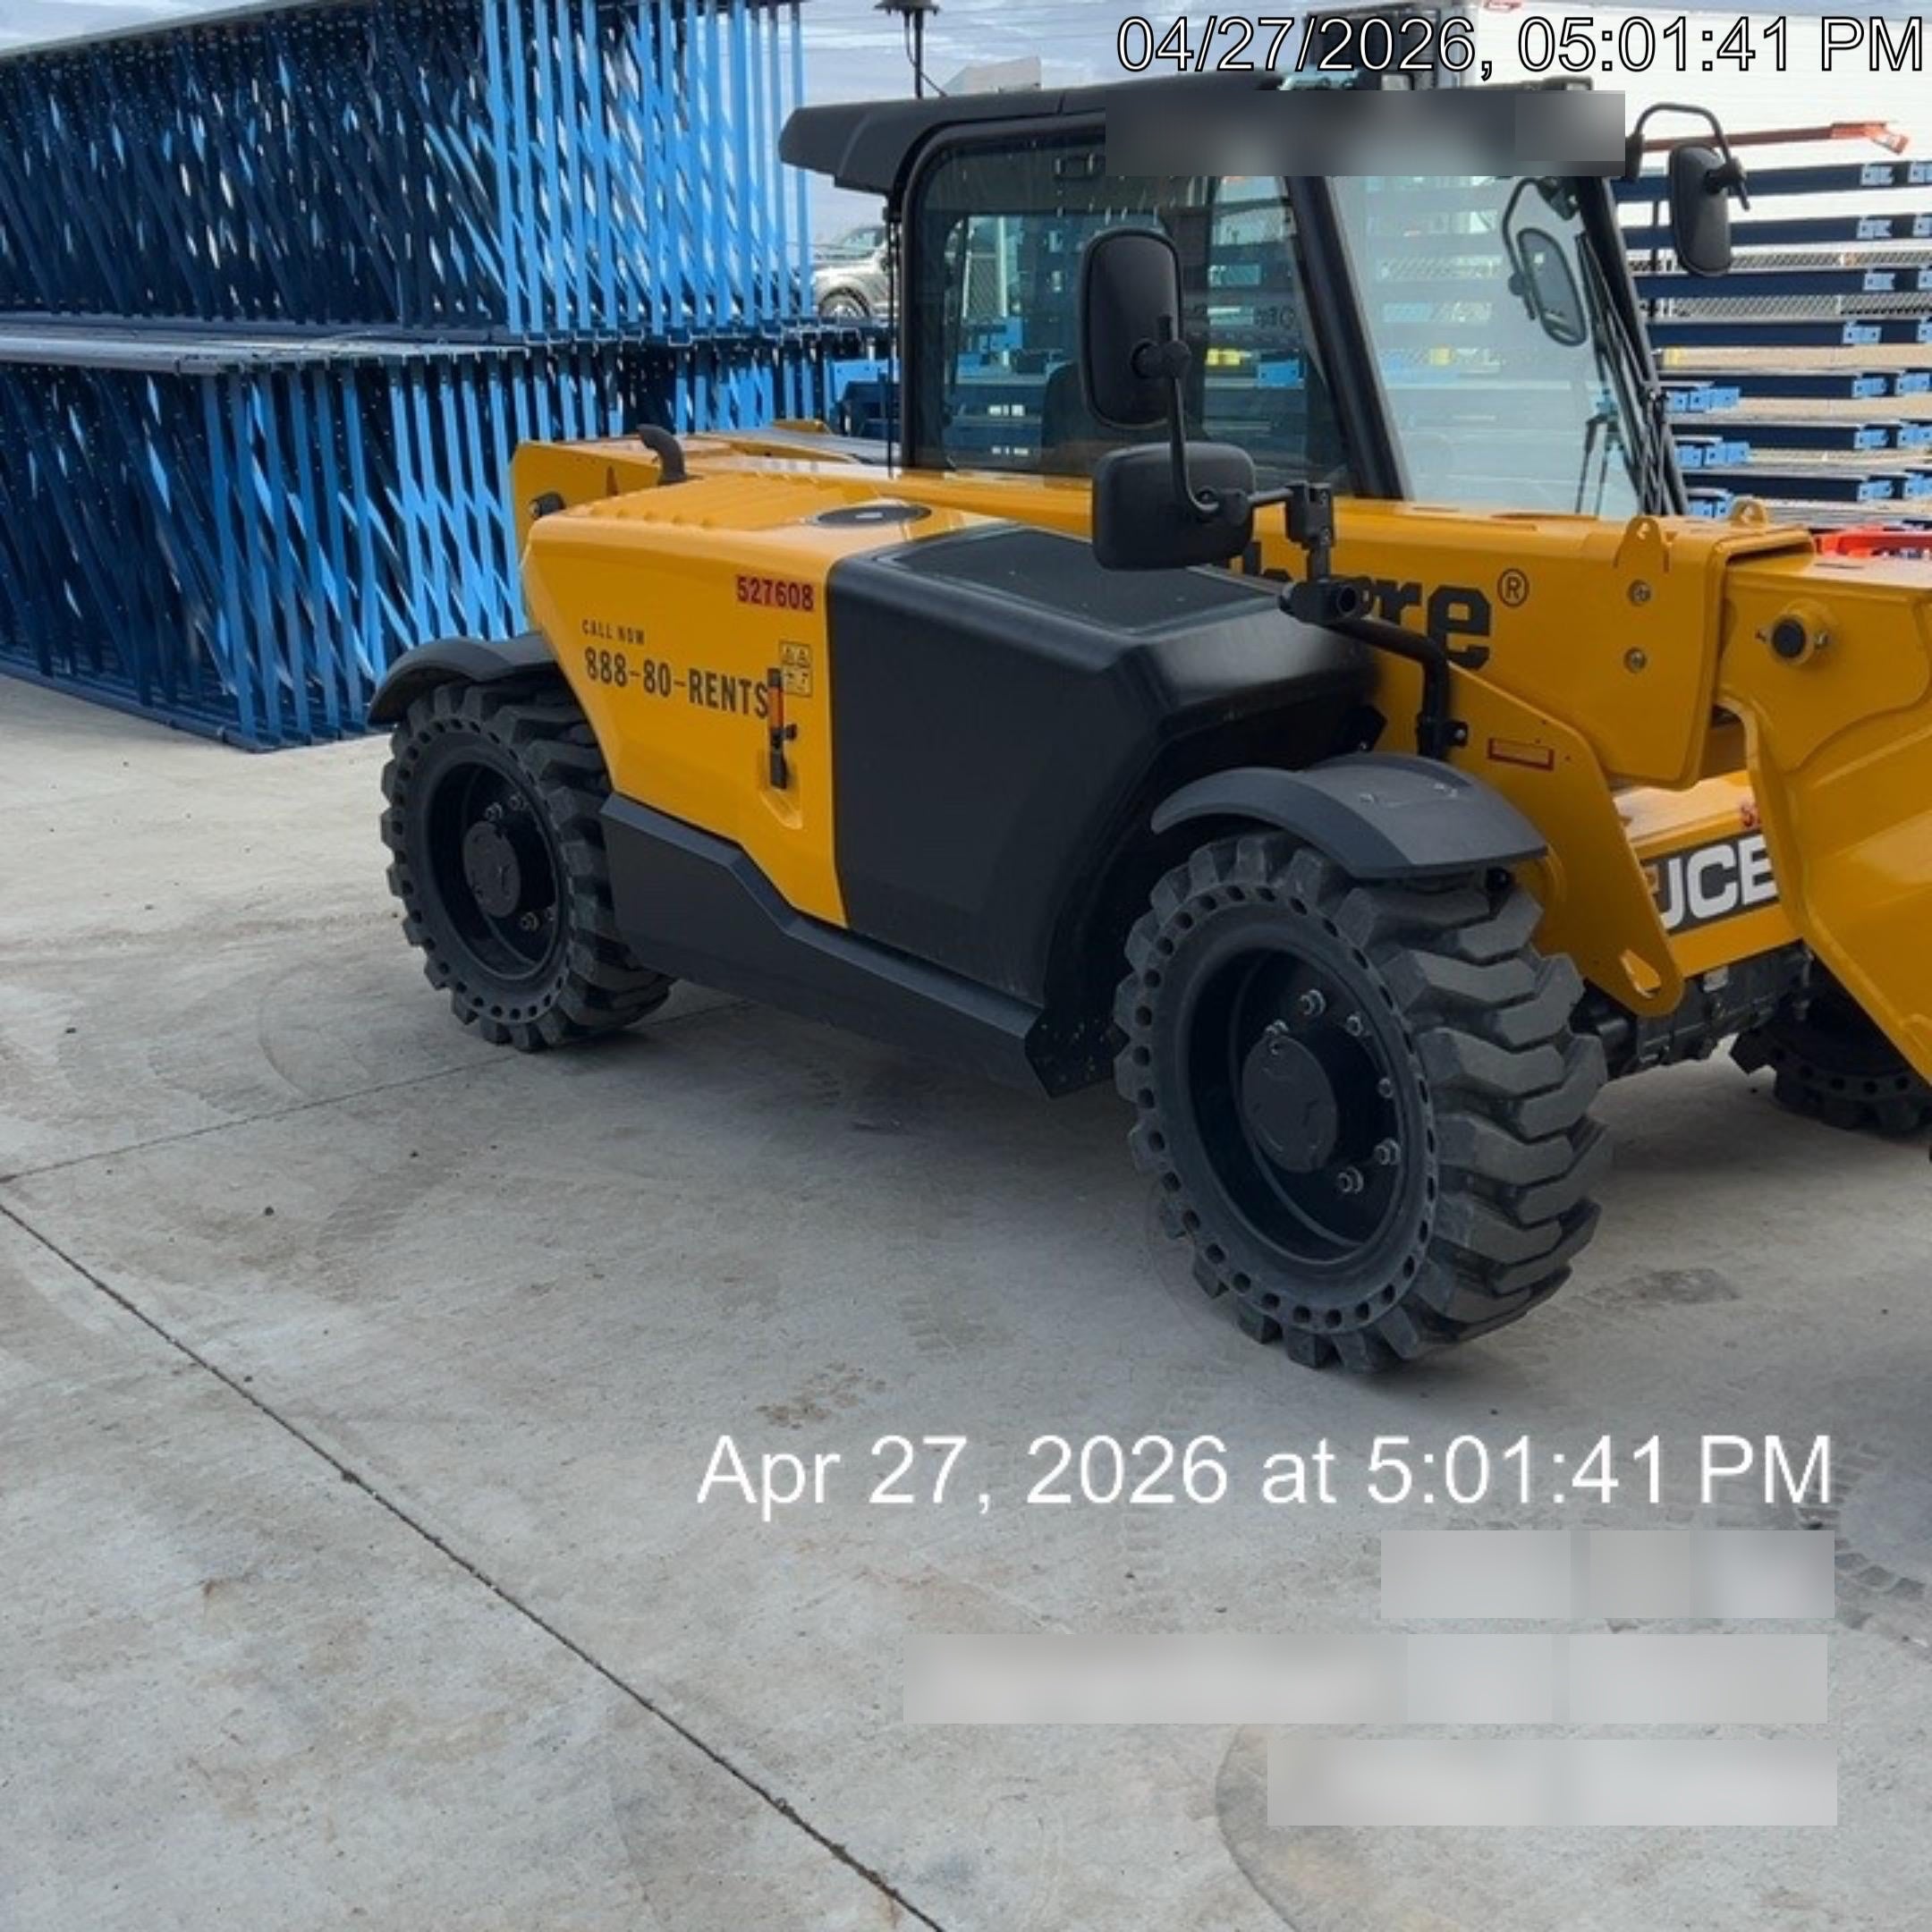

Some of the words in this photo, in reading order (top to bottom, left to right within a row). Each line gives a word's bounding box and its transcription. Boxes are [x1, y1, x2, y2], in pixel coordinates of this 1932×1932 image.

[736, 575, 815, 612] 527608
[581, 618, 613, 640] CALL
[617, 625, 646, 646] NOW
[584, 646, 768, 719] 888-80-RENTS
